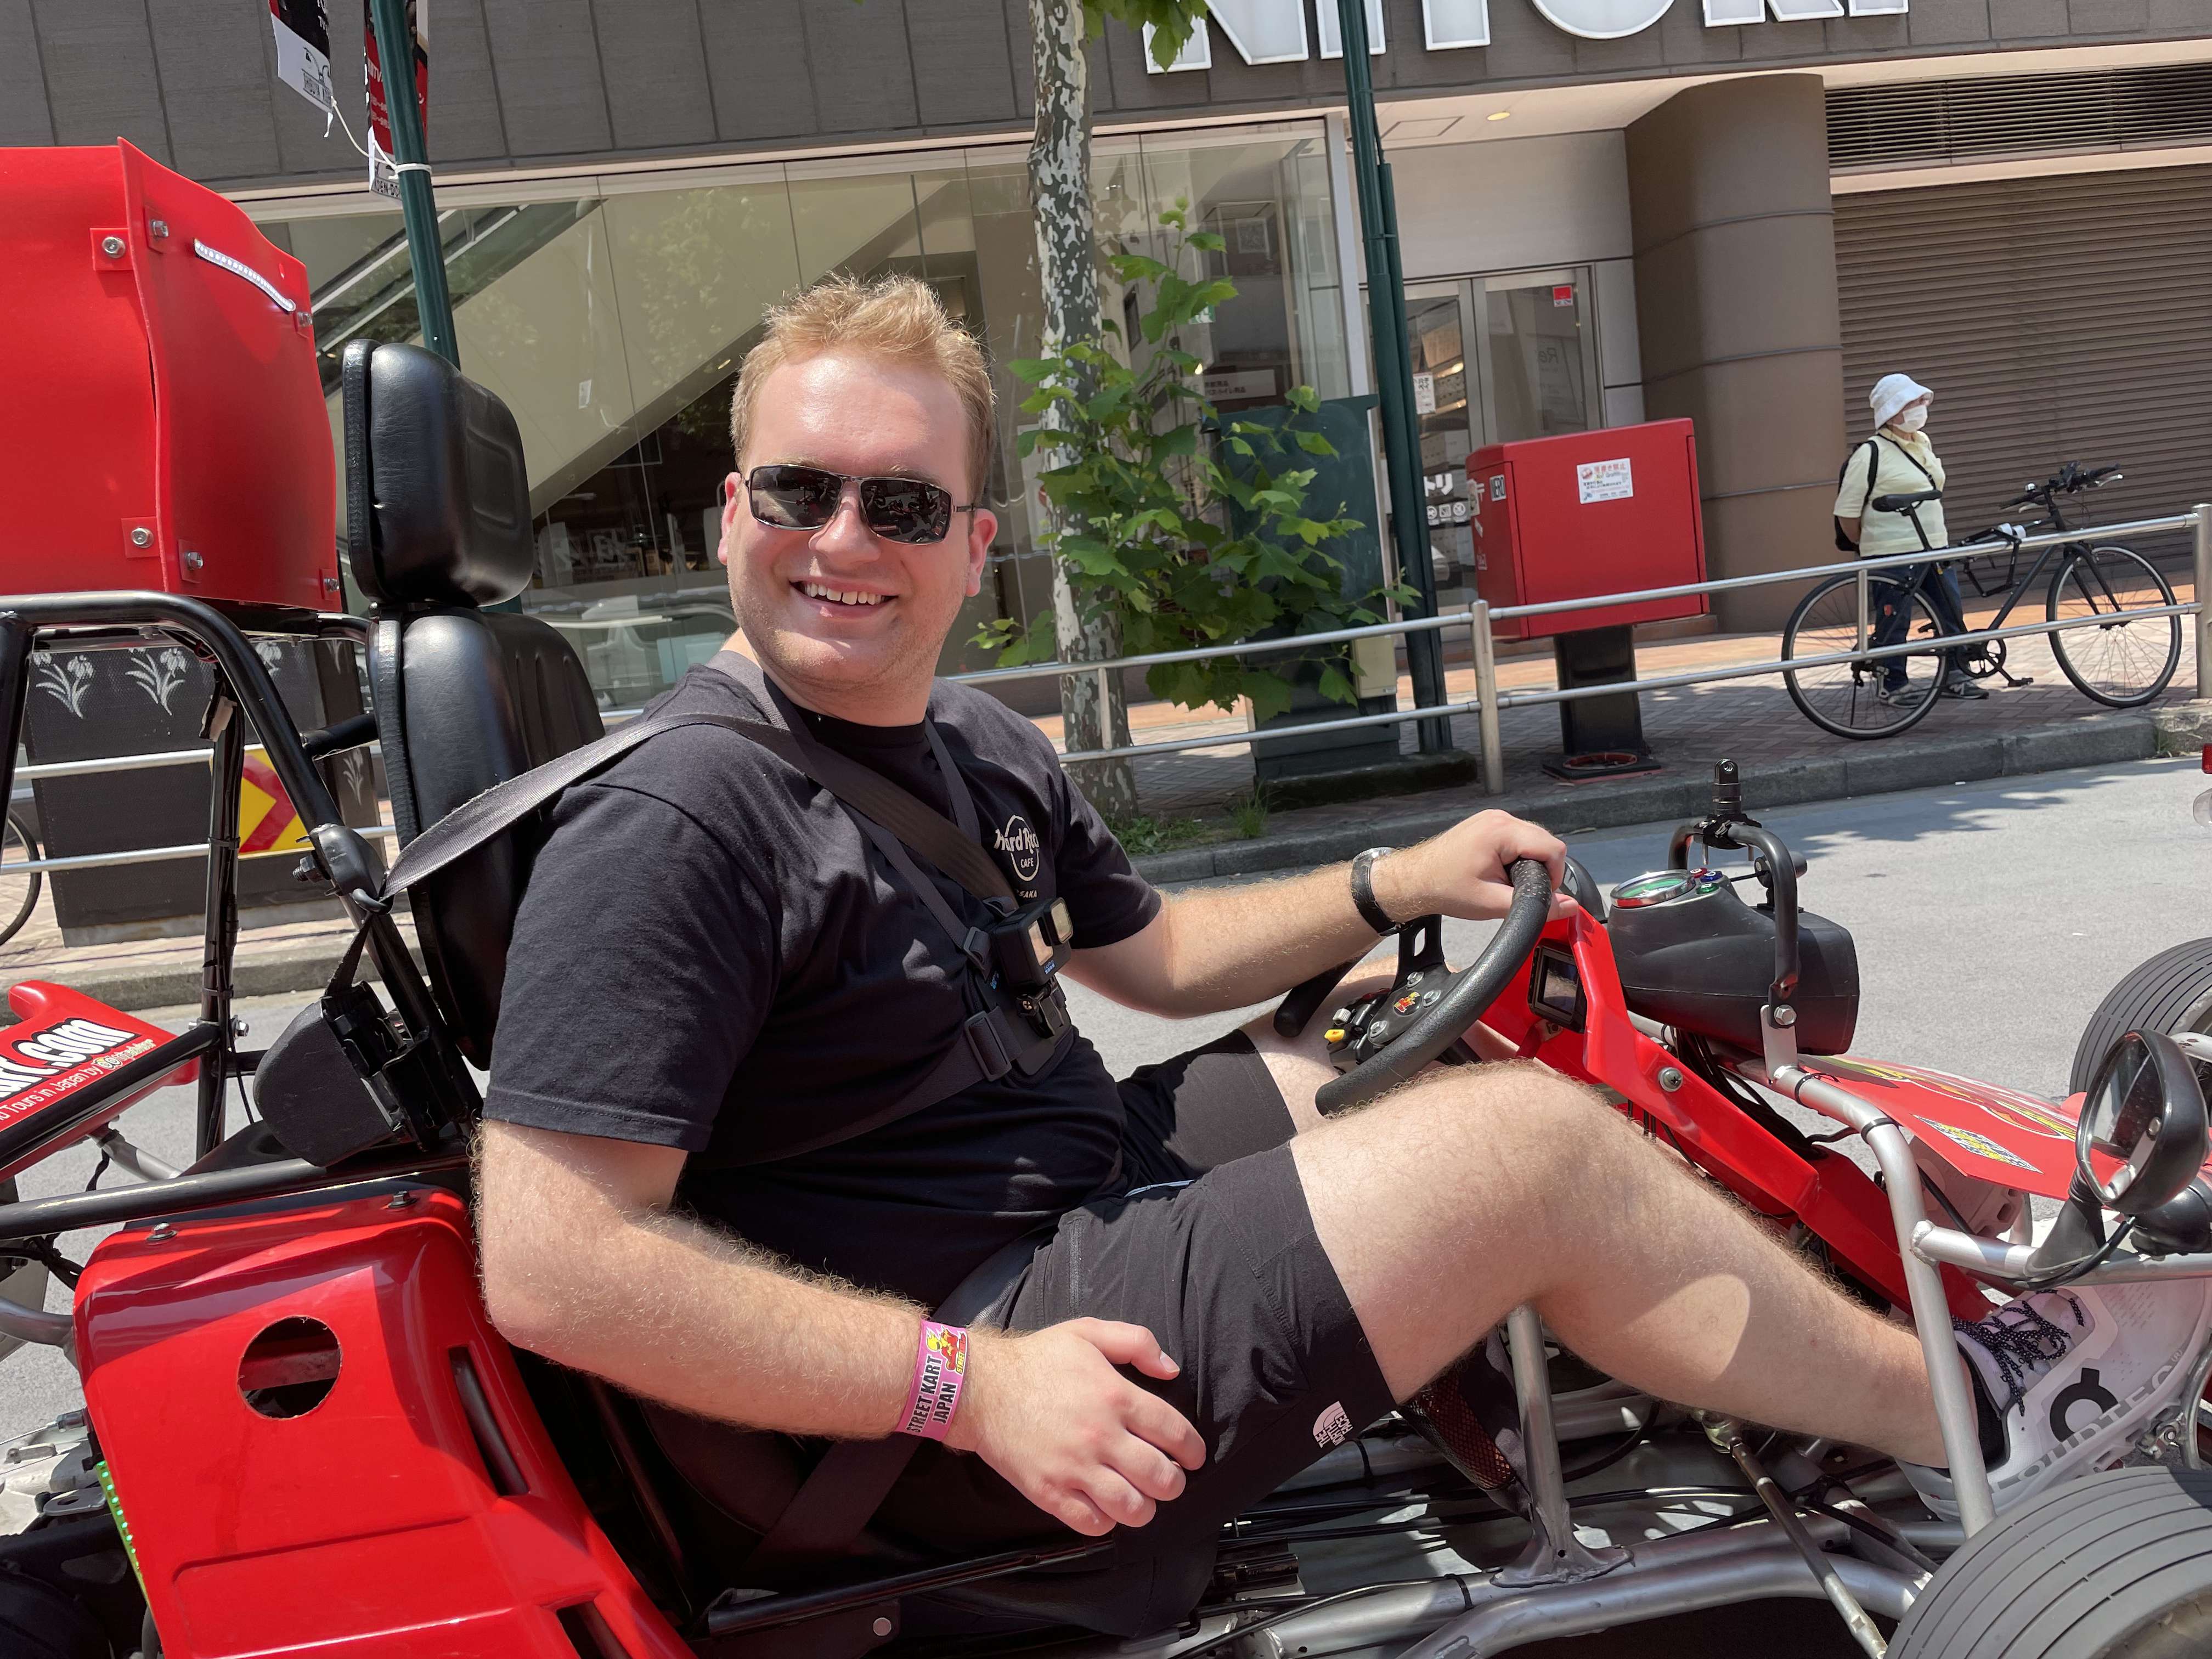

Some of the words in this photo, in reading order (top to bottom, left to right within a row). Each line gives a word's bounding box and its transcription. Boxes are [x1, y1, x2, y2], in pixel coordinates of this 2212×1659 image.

[994, 828, 1023, 851] Hard
[1020, 857, 1034, 868] CAFE
[1017, 889, 1037, 898] SAKA
[0, 1092, 44, 1114] Tours
[34, 1088, 57, 1098] in
[50, 1071, 89, 1092] Japan
[83, 1062, 104, 1076] by
[906, 1395, 933, 1433] STREET
[921, 1355, 942, 1395] KART
[933, 1383, 957, 1425] JAPAN
[1325, 1421, 1346, 1446] NORTH
[1335, 1414, 1353, 1435] FACE
[1314, 1429, 1331, 1448] THE
